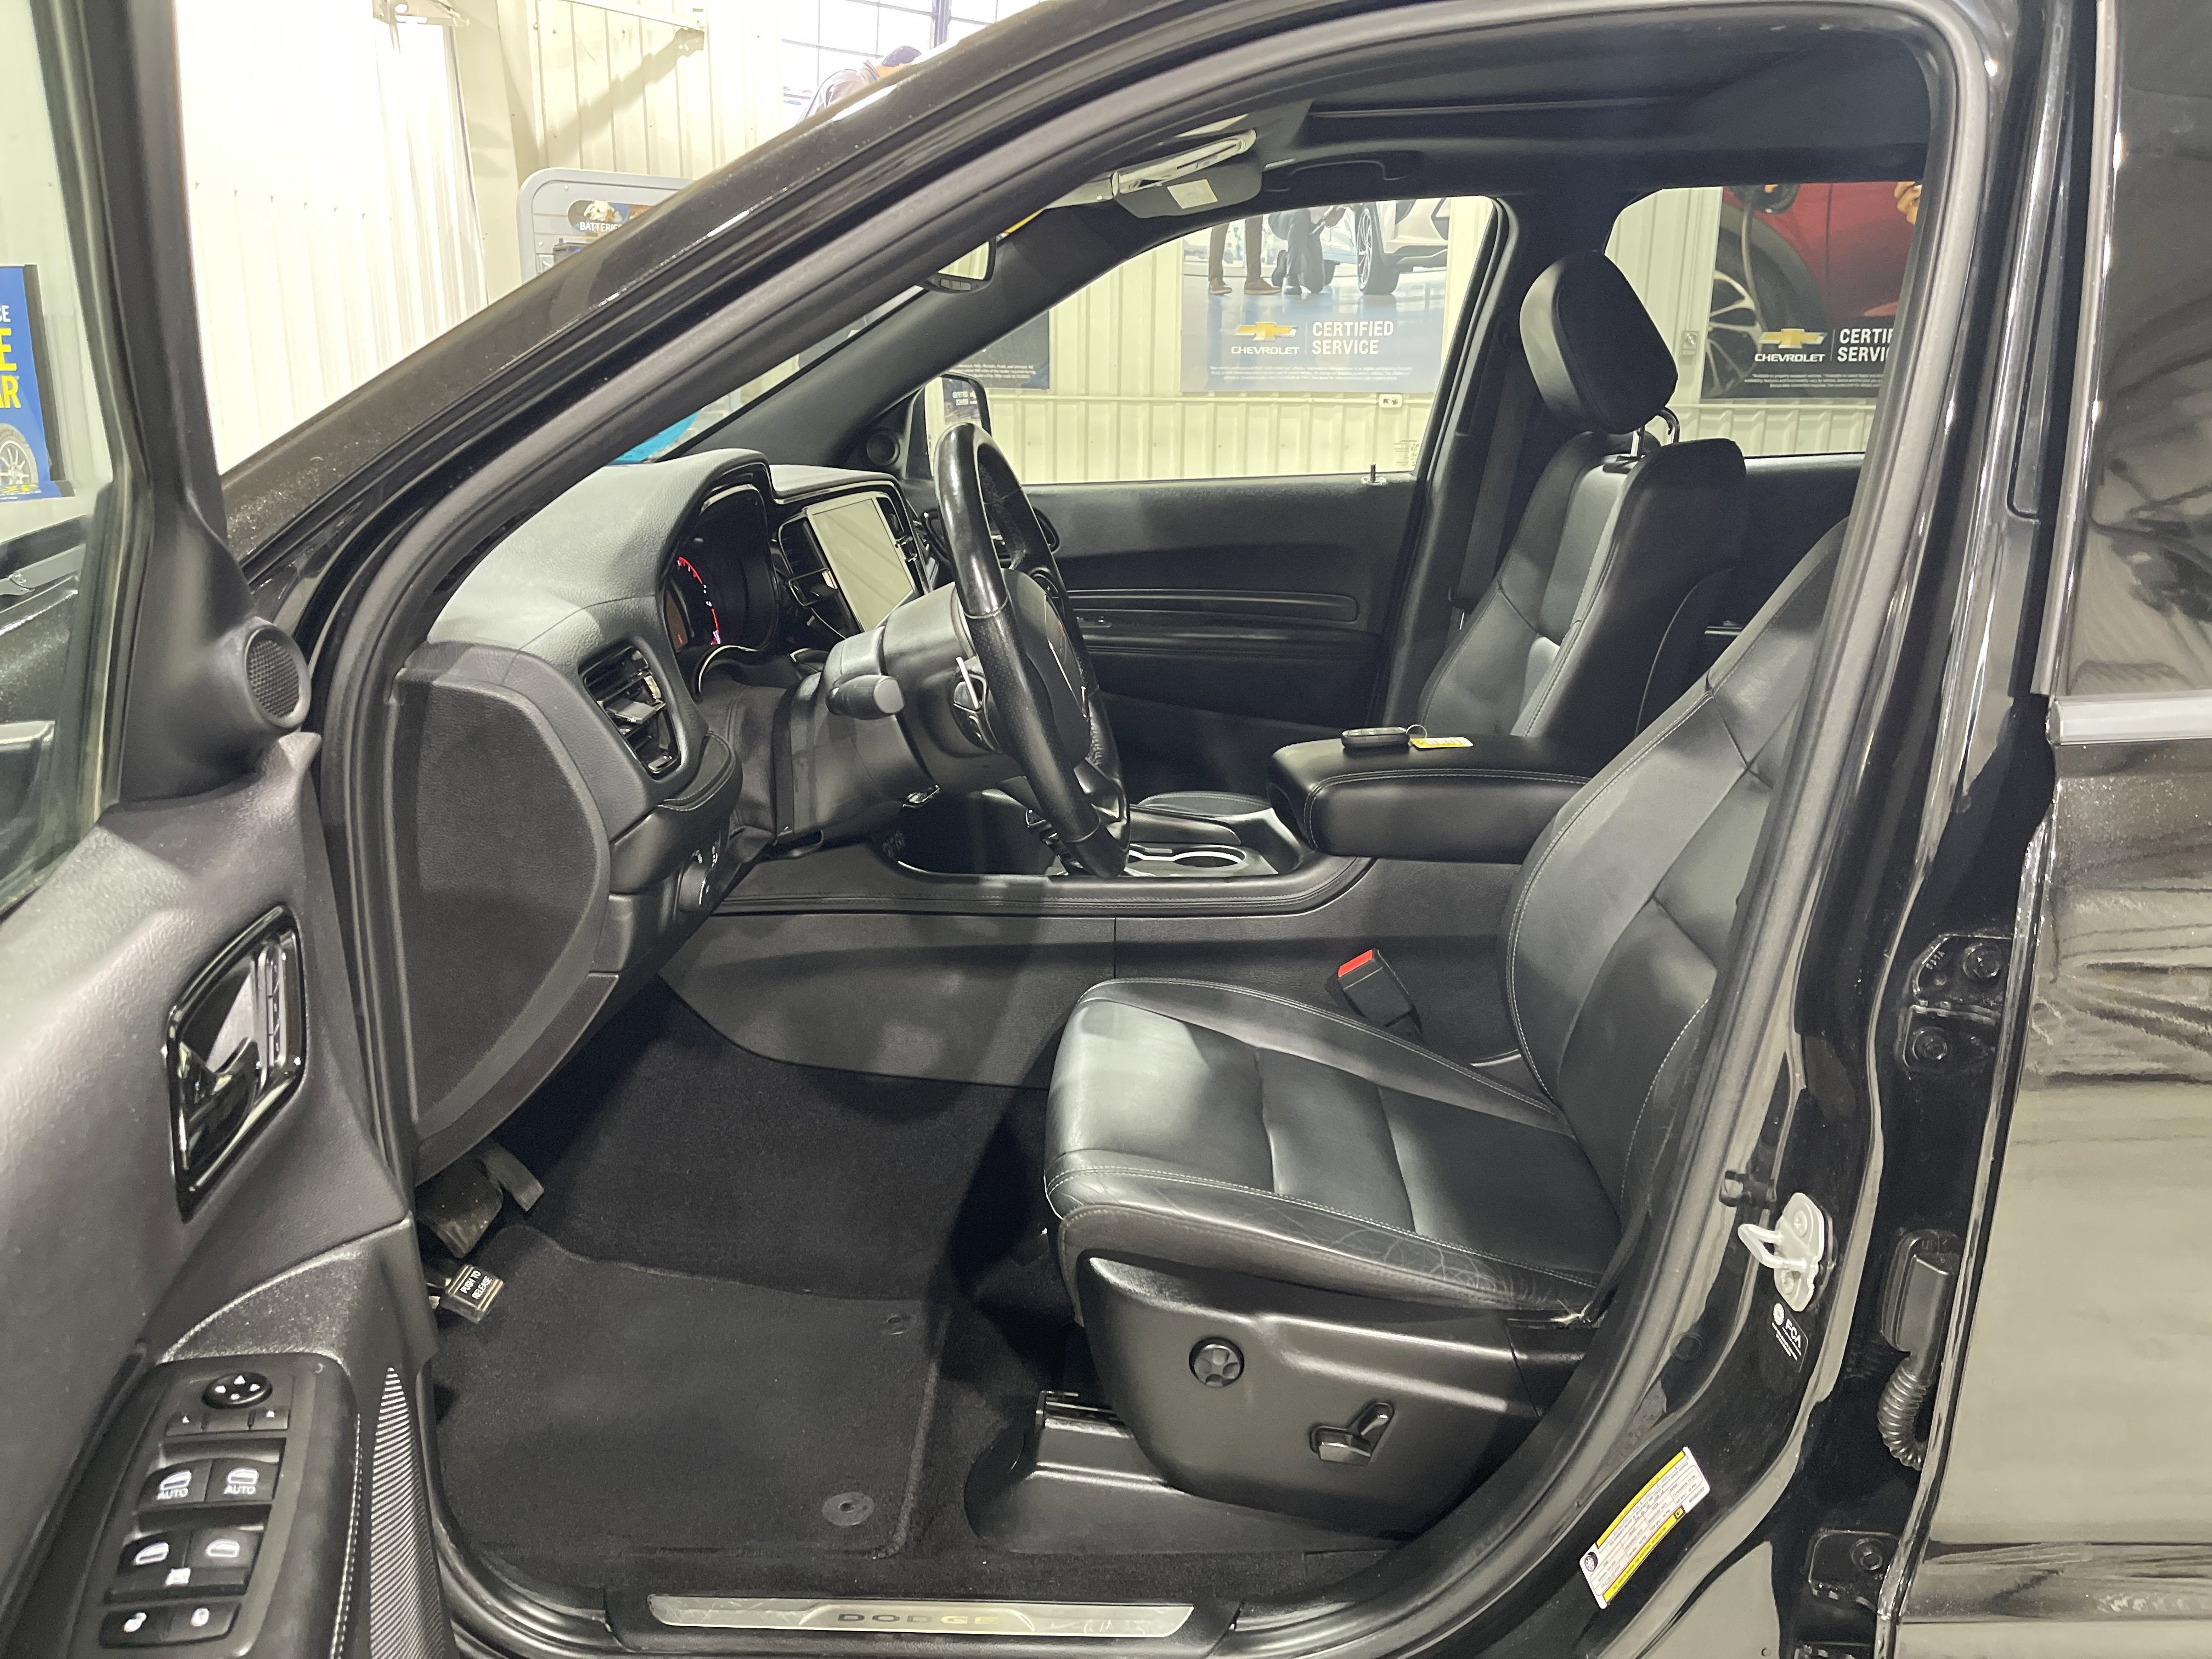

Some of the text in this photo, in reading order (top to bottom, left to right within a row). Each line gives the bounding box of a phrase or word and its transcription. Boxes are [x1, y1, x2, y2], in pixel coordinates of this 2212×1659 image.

[0, 305, 11, 322] E
[1312, 321, 1393, 336] CERTIFIED
[1231, 346, 1300, 354] CHEVROLET
[1312, 340, 1379, 354] SERVICE
[1754, 353, 1826, 362] CHEVROLET
[0, 375, 21, 409] R
[460, 1270, 481, 1294] PUSH TO
[471, 1276, 493, 1300] RELEASE
[156, 1487, 189, 1501] AUTO
[224, 1485, 256, 1495] AUTO
[838, 1613, 1000, 1624] DODGE
